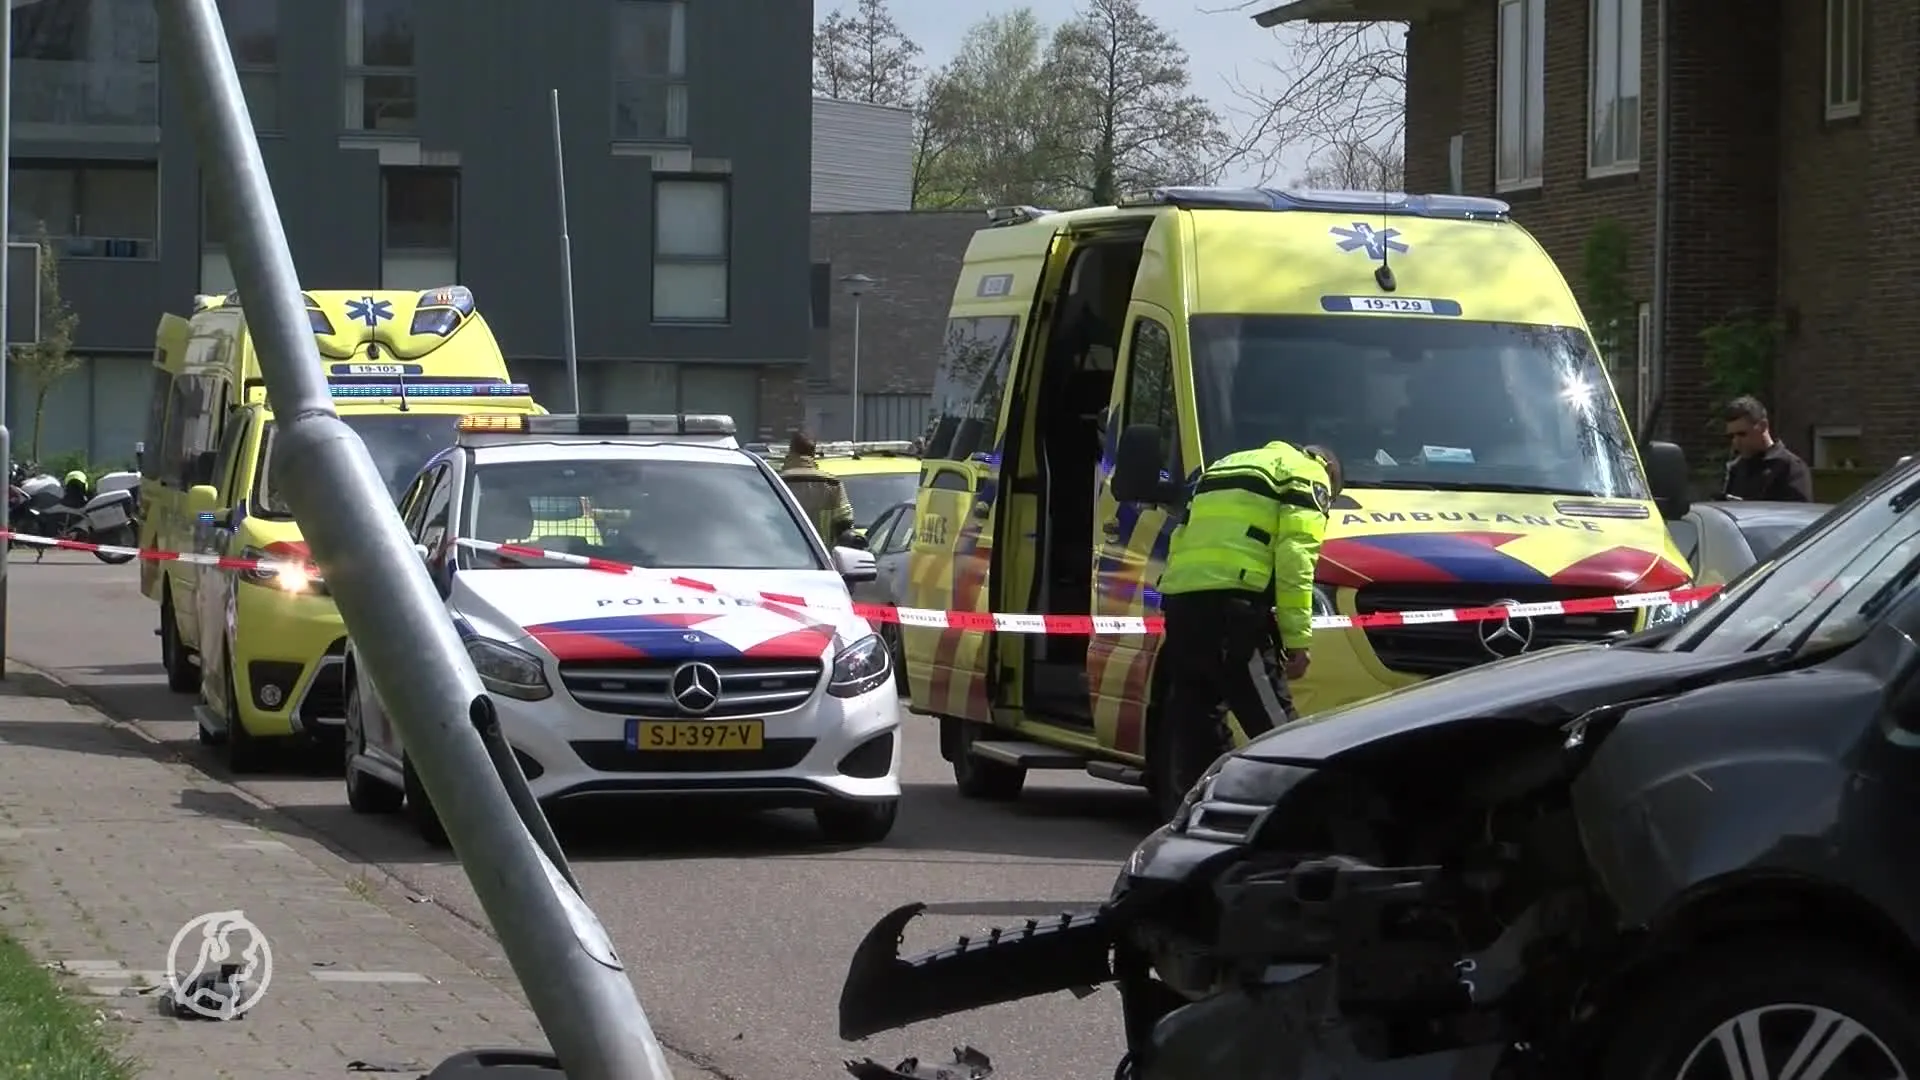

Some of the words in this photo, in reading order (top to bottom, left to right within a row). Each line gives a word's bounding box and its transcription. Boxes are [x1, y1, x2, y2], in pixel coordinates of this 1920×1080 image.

[1363, 299, 1422, 311] 19-129
[358, 364, 397, 373] 19-105
[1342, 511, 1605, 533] AMBULANCE
[597, 597, 757, 607] POLITIE
[650, 725, 752, 746] SJ-397-V
